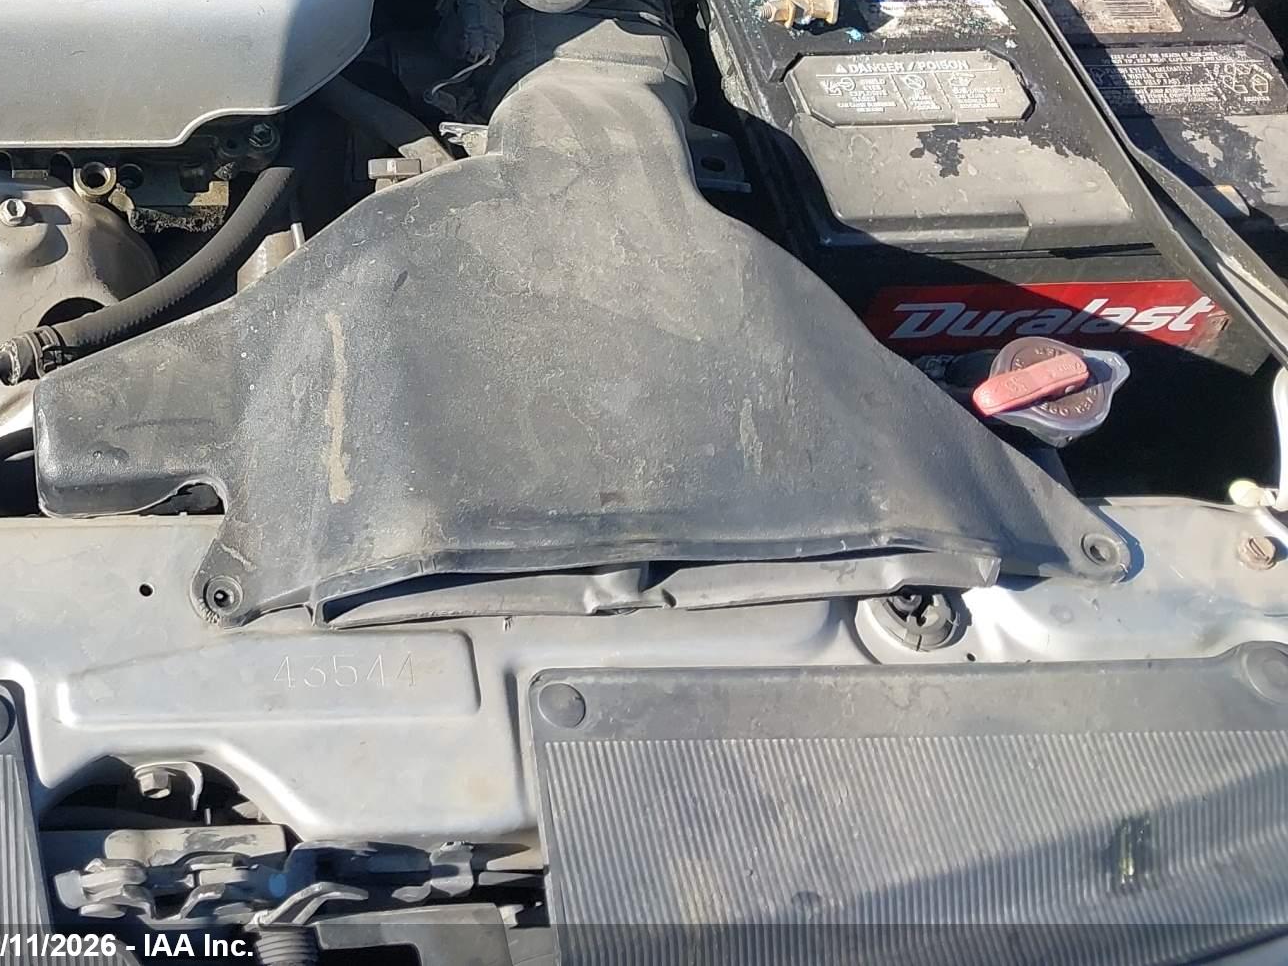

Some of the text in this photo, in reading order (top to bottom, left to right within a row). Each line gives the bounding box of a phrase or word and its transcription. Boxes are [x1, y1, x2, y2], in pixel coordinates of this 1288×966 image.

[848, 62, 905, 74] DANGER
[918, 60, 970, 71] POISON
[888, 297, 1216, 339] Duralast
